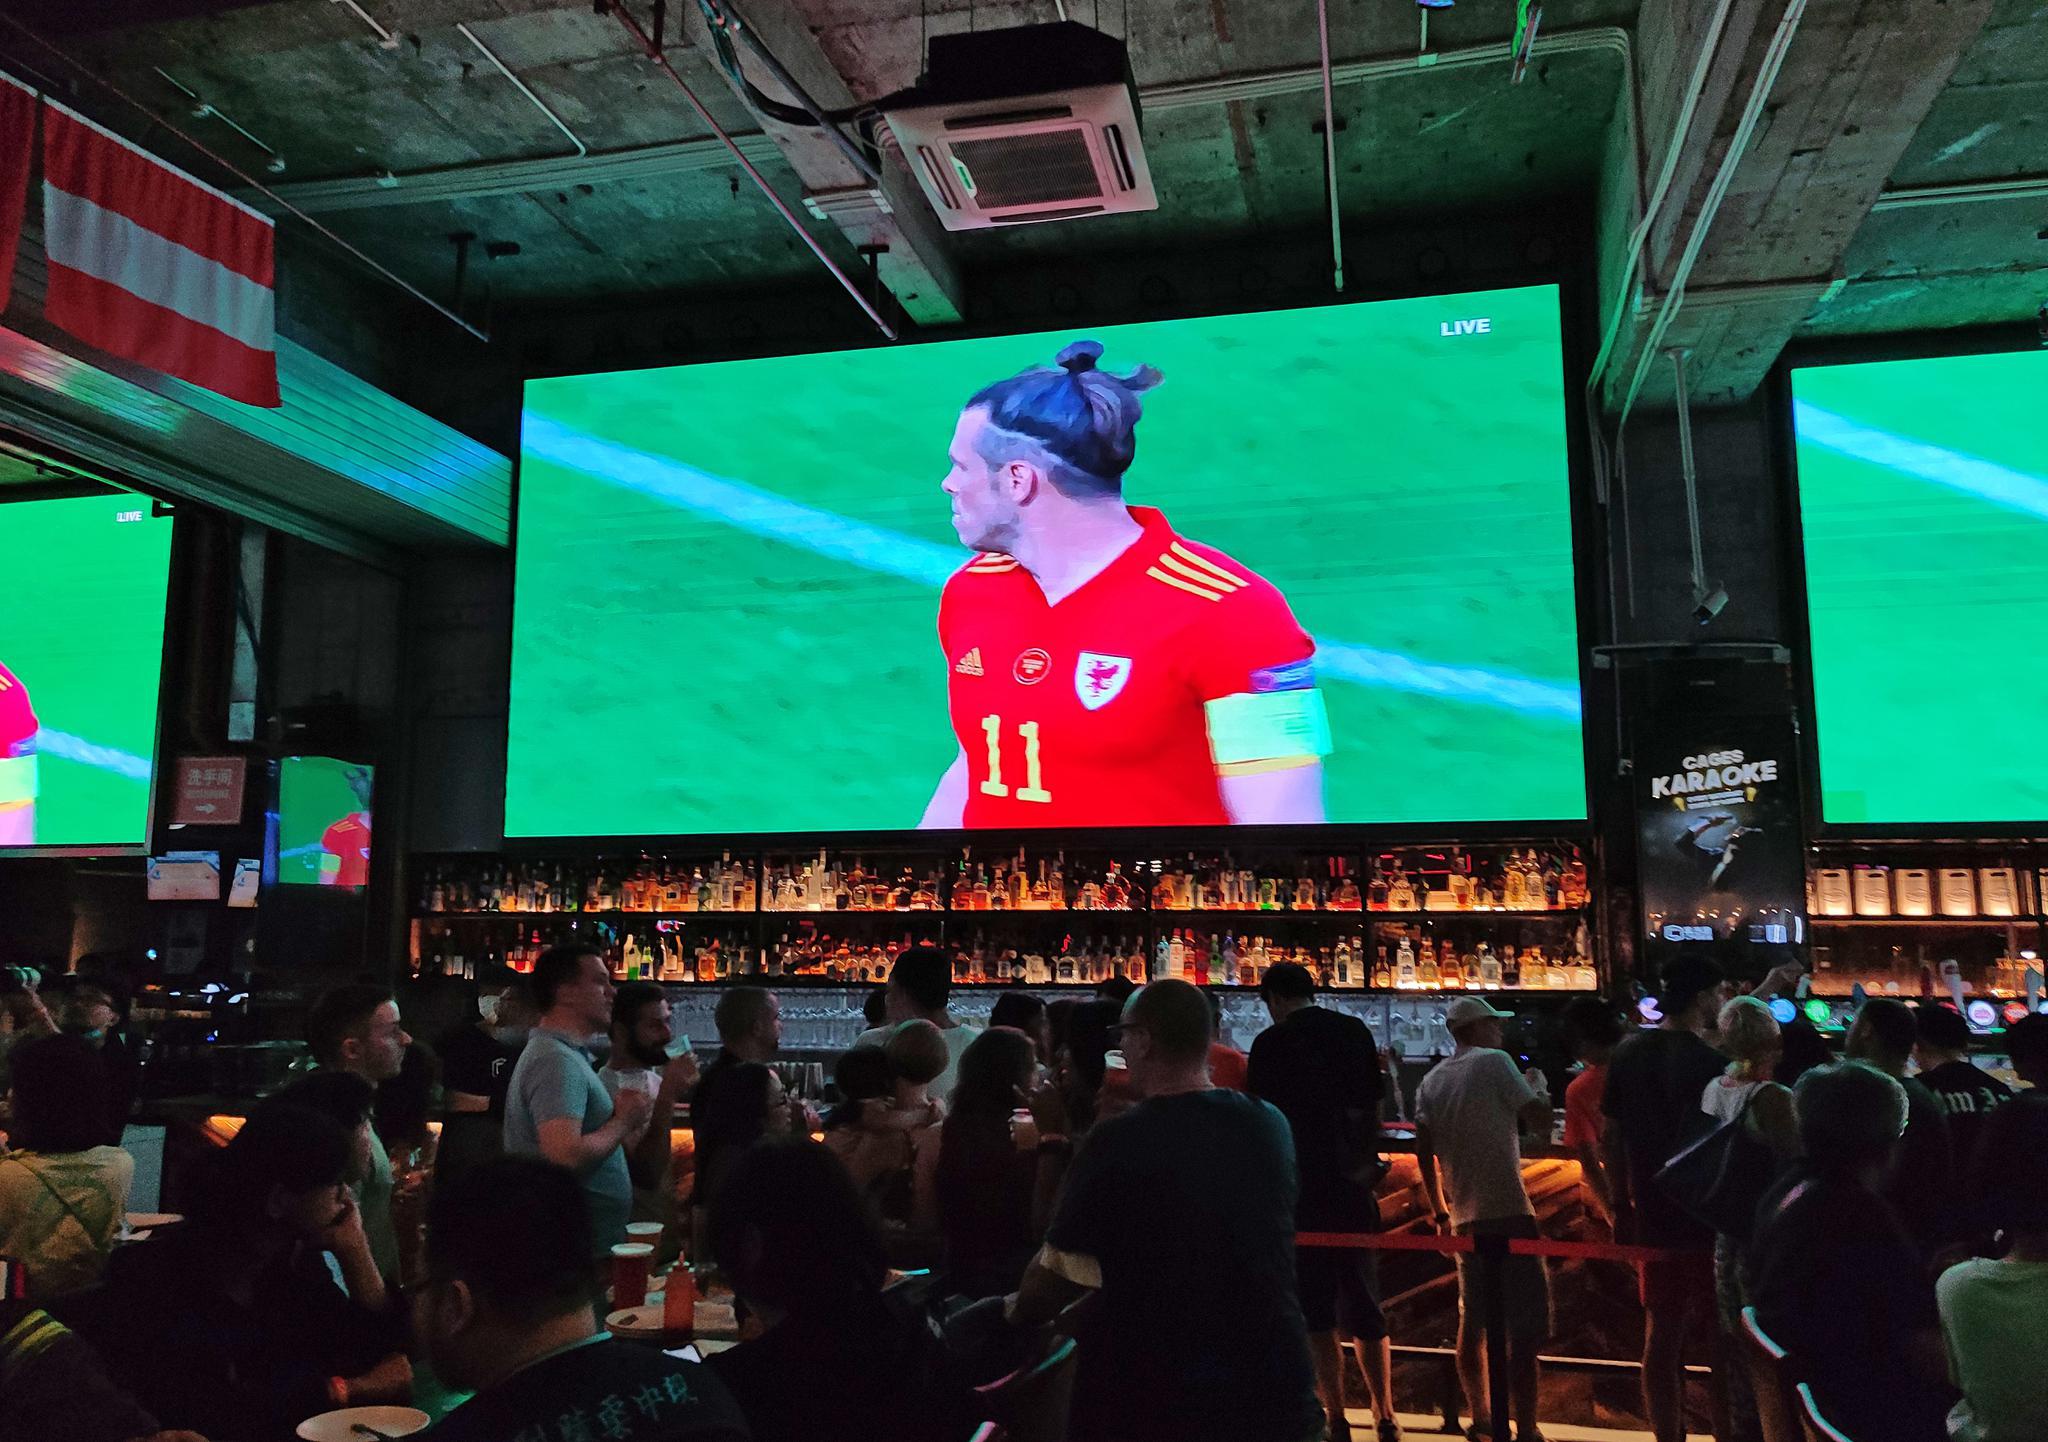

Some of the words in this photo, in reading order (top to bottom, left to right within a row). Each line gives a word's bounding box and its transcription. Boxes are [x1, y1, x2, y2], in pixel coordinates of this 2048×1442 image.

[1441, 318, 1491, 336] LIVE
[116, 510, 143, 522] LIVE
[980, 714, 1052, 803] 11
[1651, 759, 1778, 799] KARAOKE
